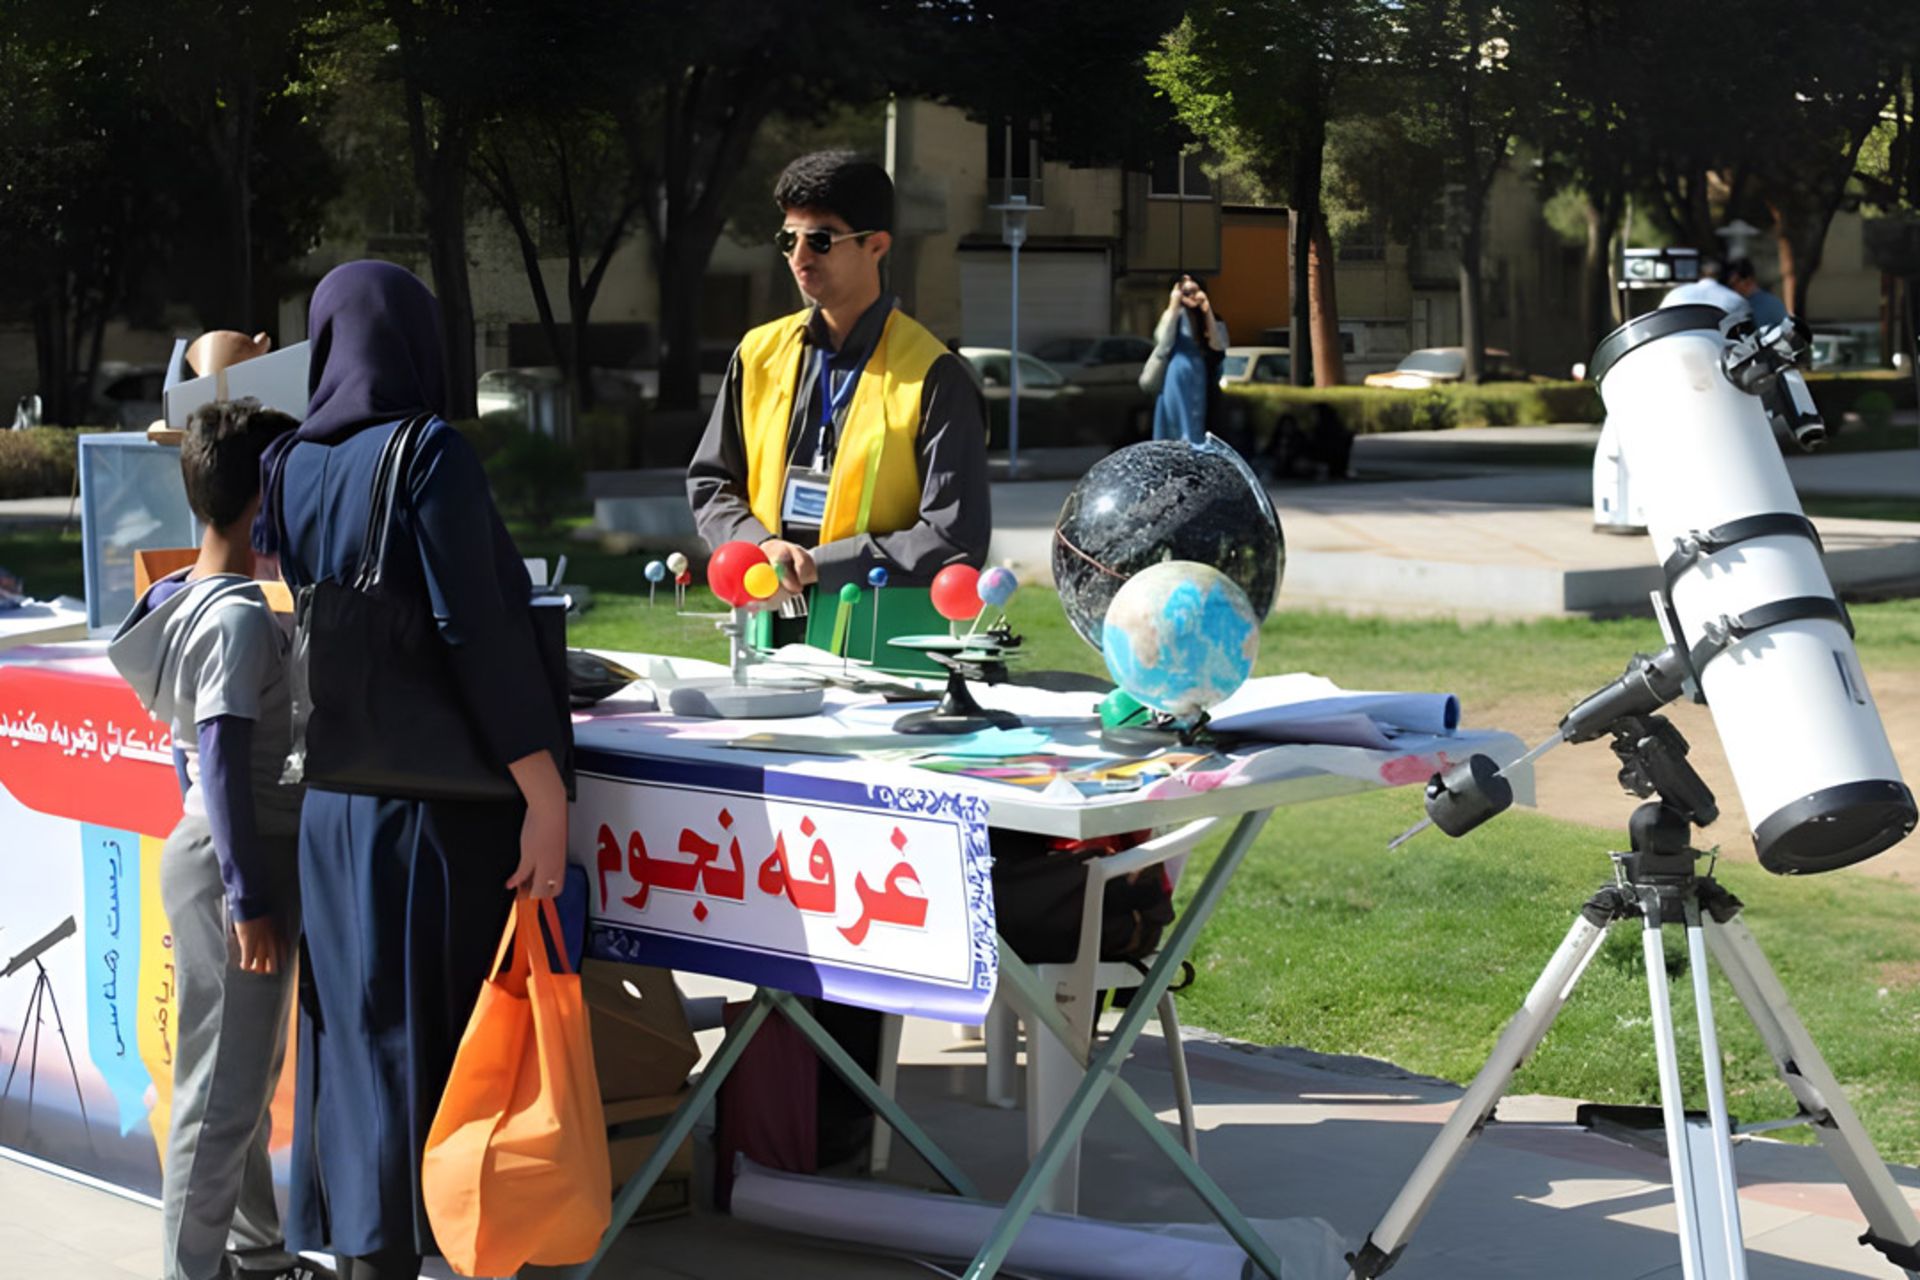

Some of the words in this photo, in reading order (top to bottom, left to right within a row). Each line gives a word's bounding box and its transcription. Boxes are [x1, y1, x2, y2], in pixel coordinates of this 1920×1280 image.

[0, 709, 48, 747] کنید
[50, 719, 98, 757] تجربه
[102, 840, 123, 937] زیست
[597, 807, 745, 923] نجوم
[758, 815, 929, 946] غرفه
